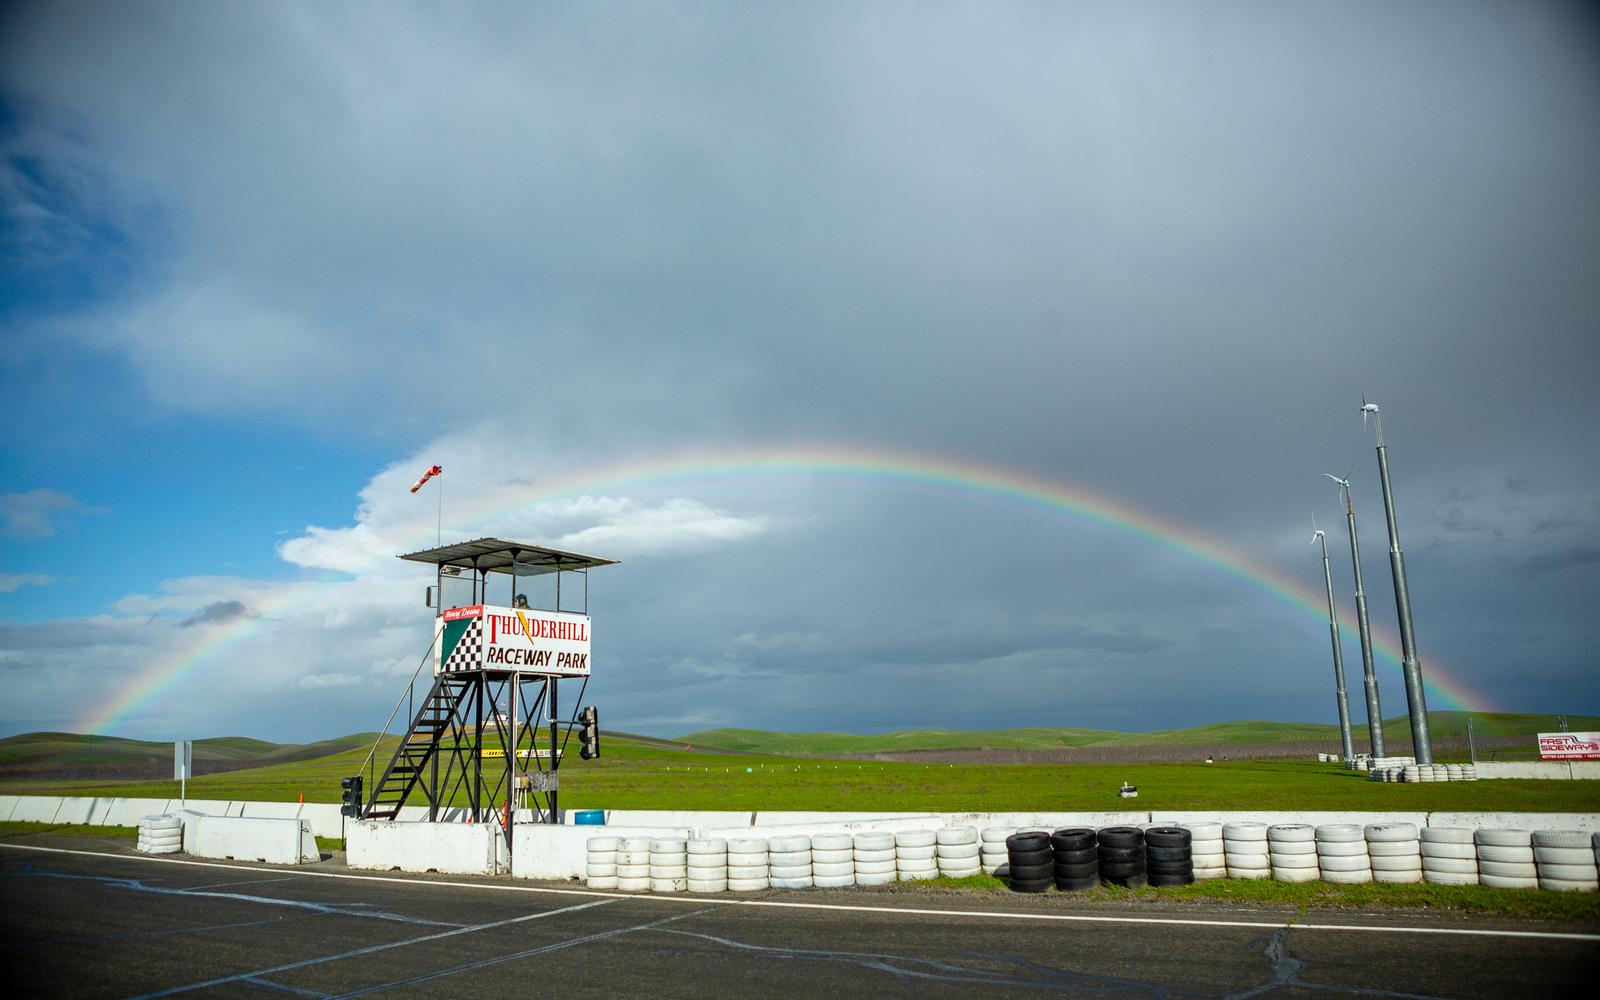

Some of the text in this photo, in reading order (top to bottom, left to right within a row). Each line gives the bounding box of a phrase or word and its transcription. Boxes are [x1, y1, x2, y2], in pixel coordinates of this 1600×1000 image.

[487, 614, 588, 644] THUNDERHILL
[487, 647, 588, 669] RACEWAY PARK
